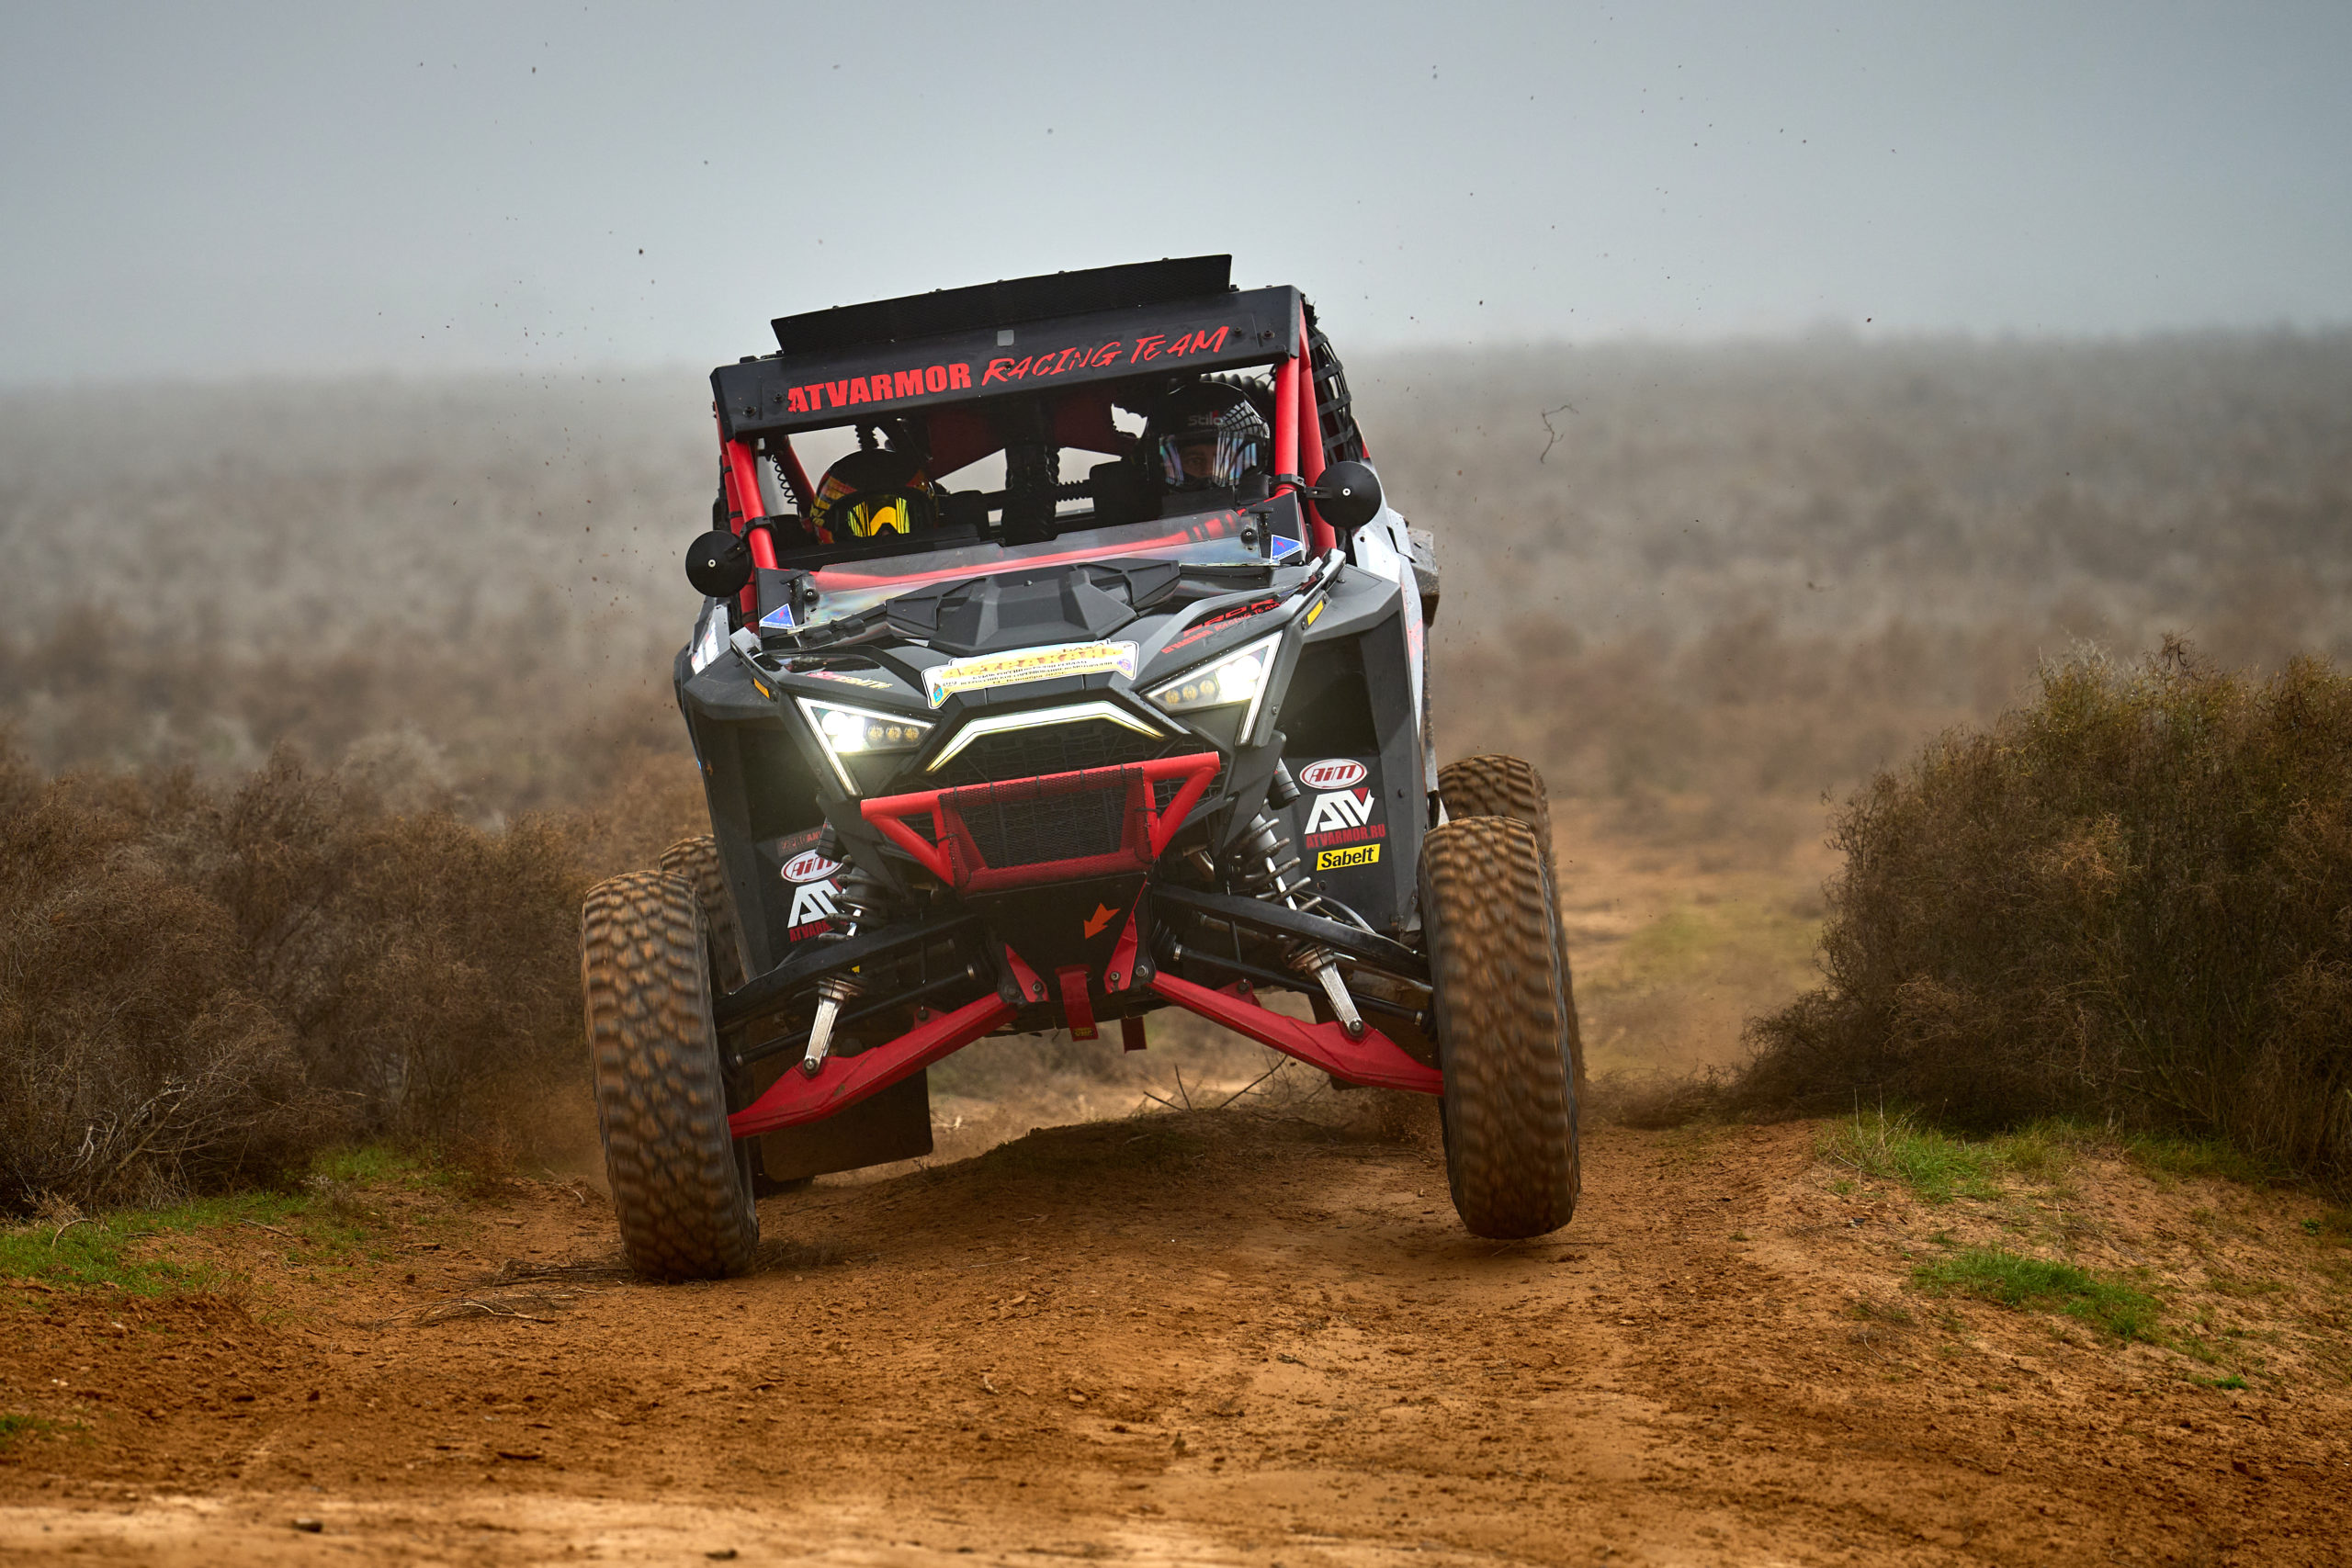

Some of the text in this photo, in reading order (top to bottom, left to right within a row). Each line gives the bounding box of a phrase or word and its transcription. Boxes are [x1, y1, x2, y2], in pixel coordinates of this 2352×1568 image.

[787, 325, 1230, 413] ATVARMOR RACING TEAM
[1306, 823, 1386, 849] ATVARMOR.RU
[1321, 847, 1374, 868] Sabelt
